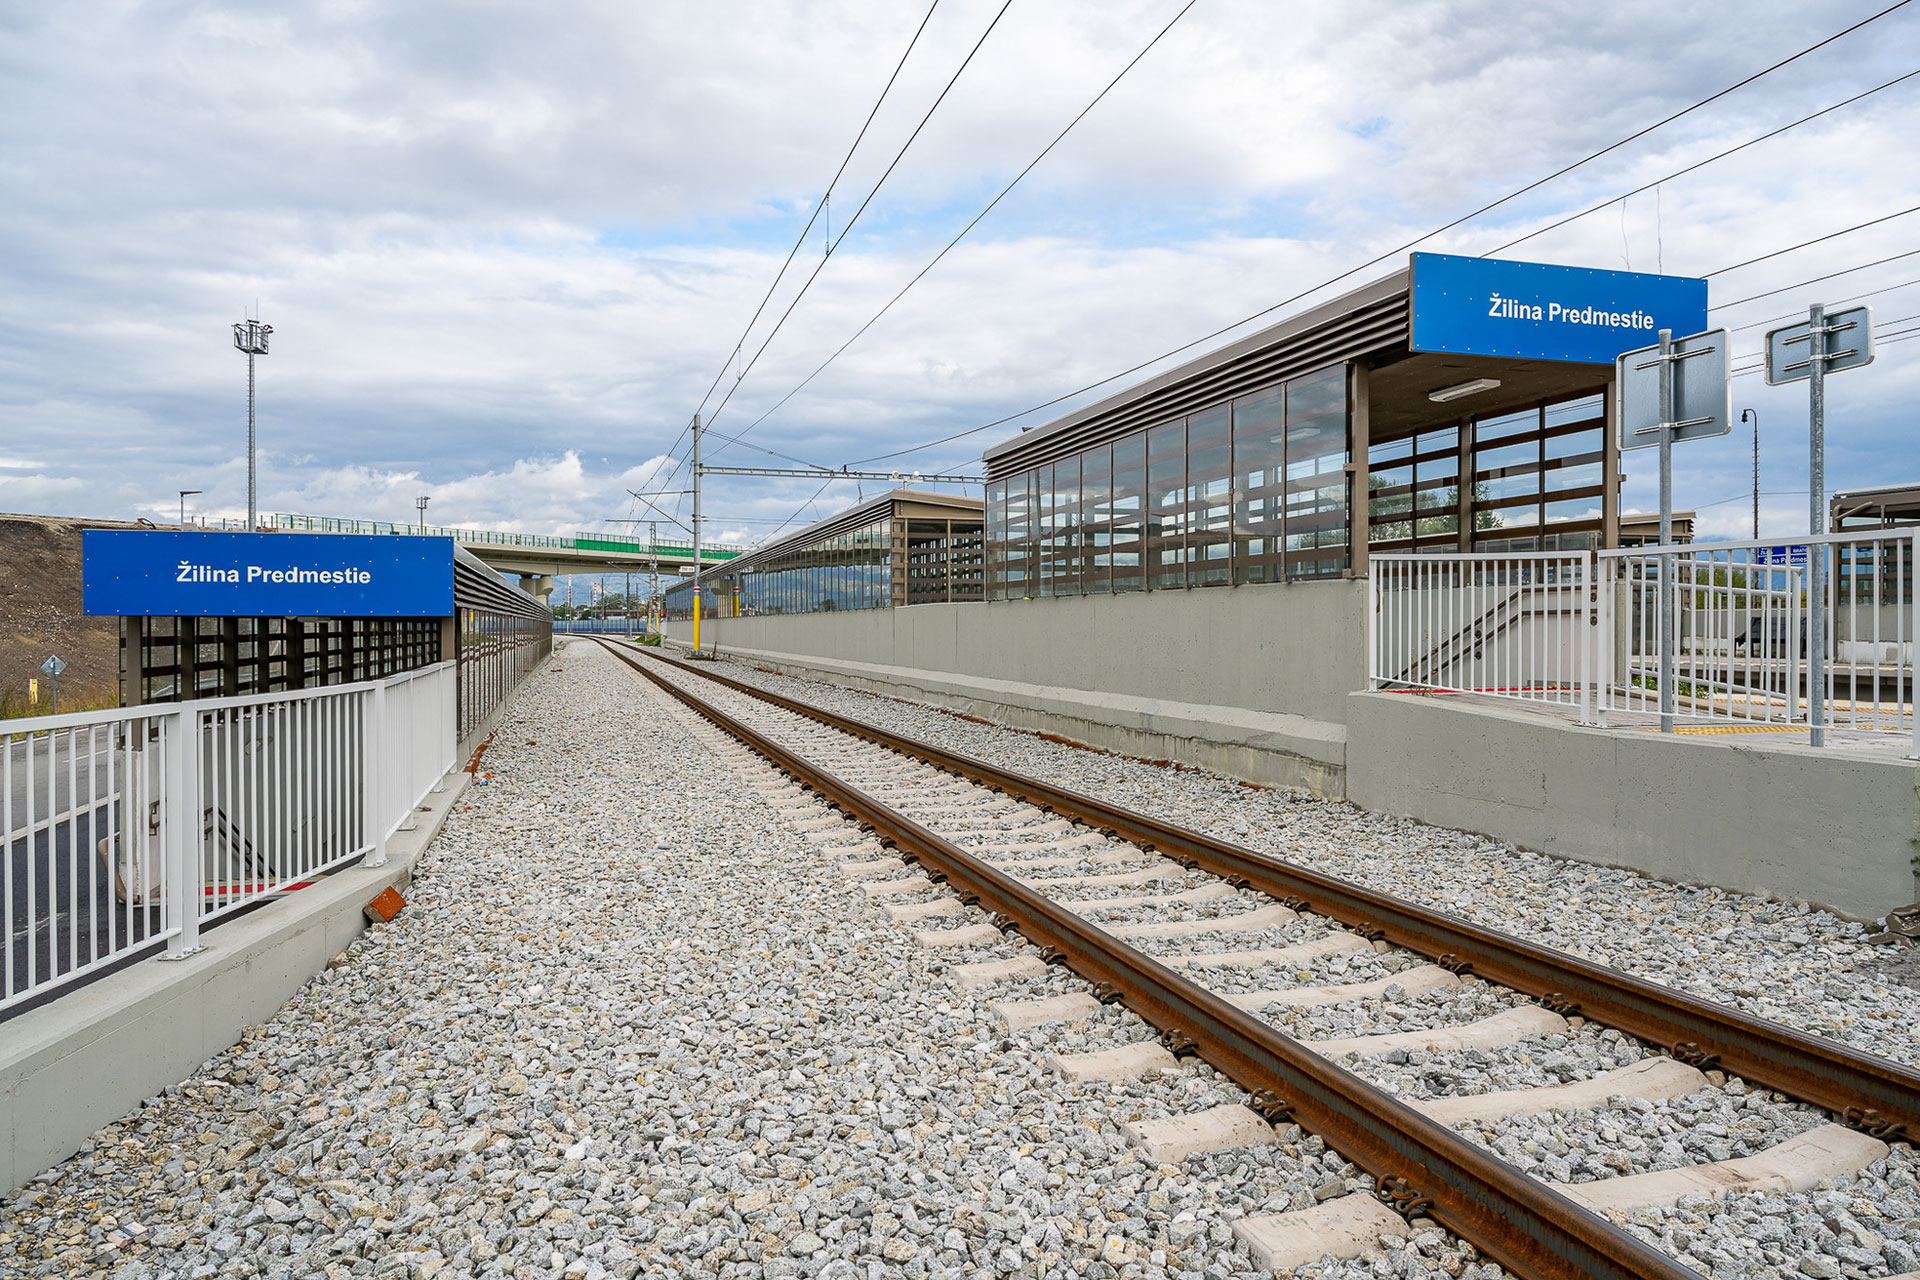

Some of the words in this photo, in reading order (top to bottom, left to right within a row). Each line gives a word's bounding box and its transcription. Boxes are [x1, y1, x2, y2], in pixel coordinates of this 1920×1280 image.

[1488, 292, 1543, 321] Žilina
[1548, 302, 1654, 330] Predmestie
[176, 560, 240, 583] Žilina
[247, 565, 371, 584] Predmestie
